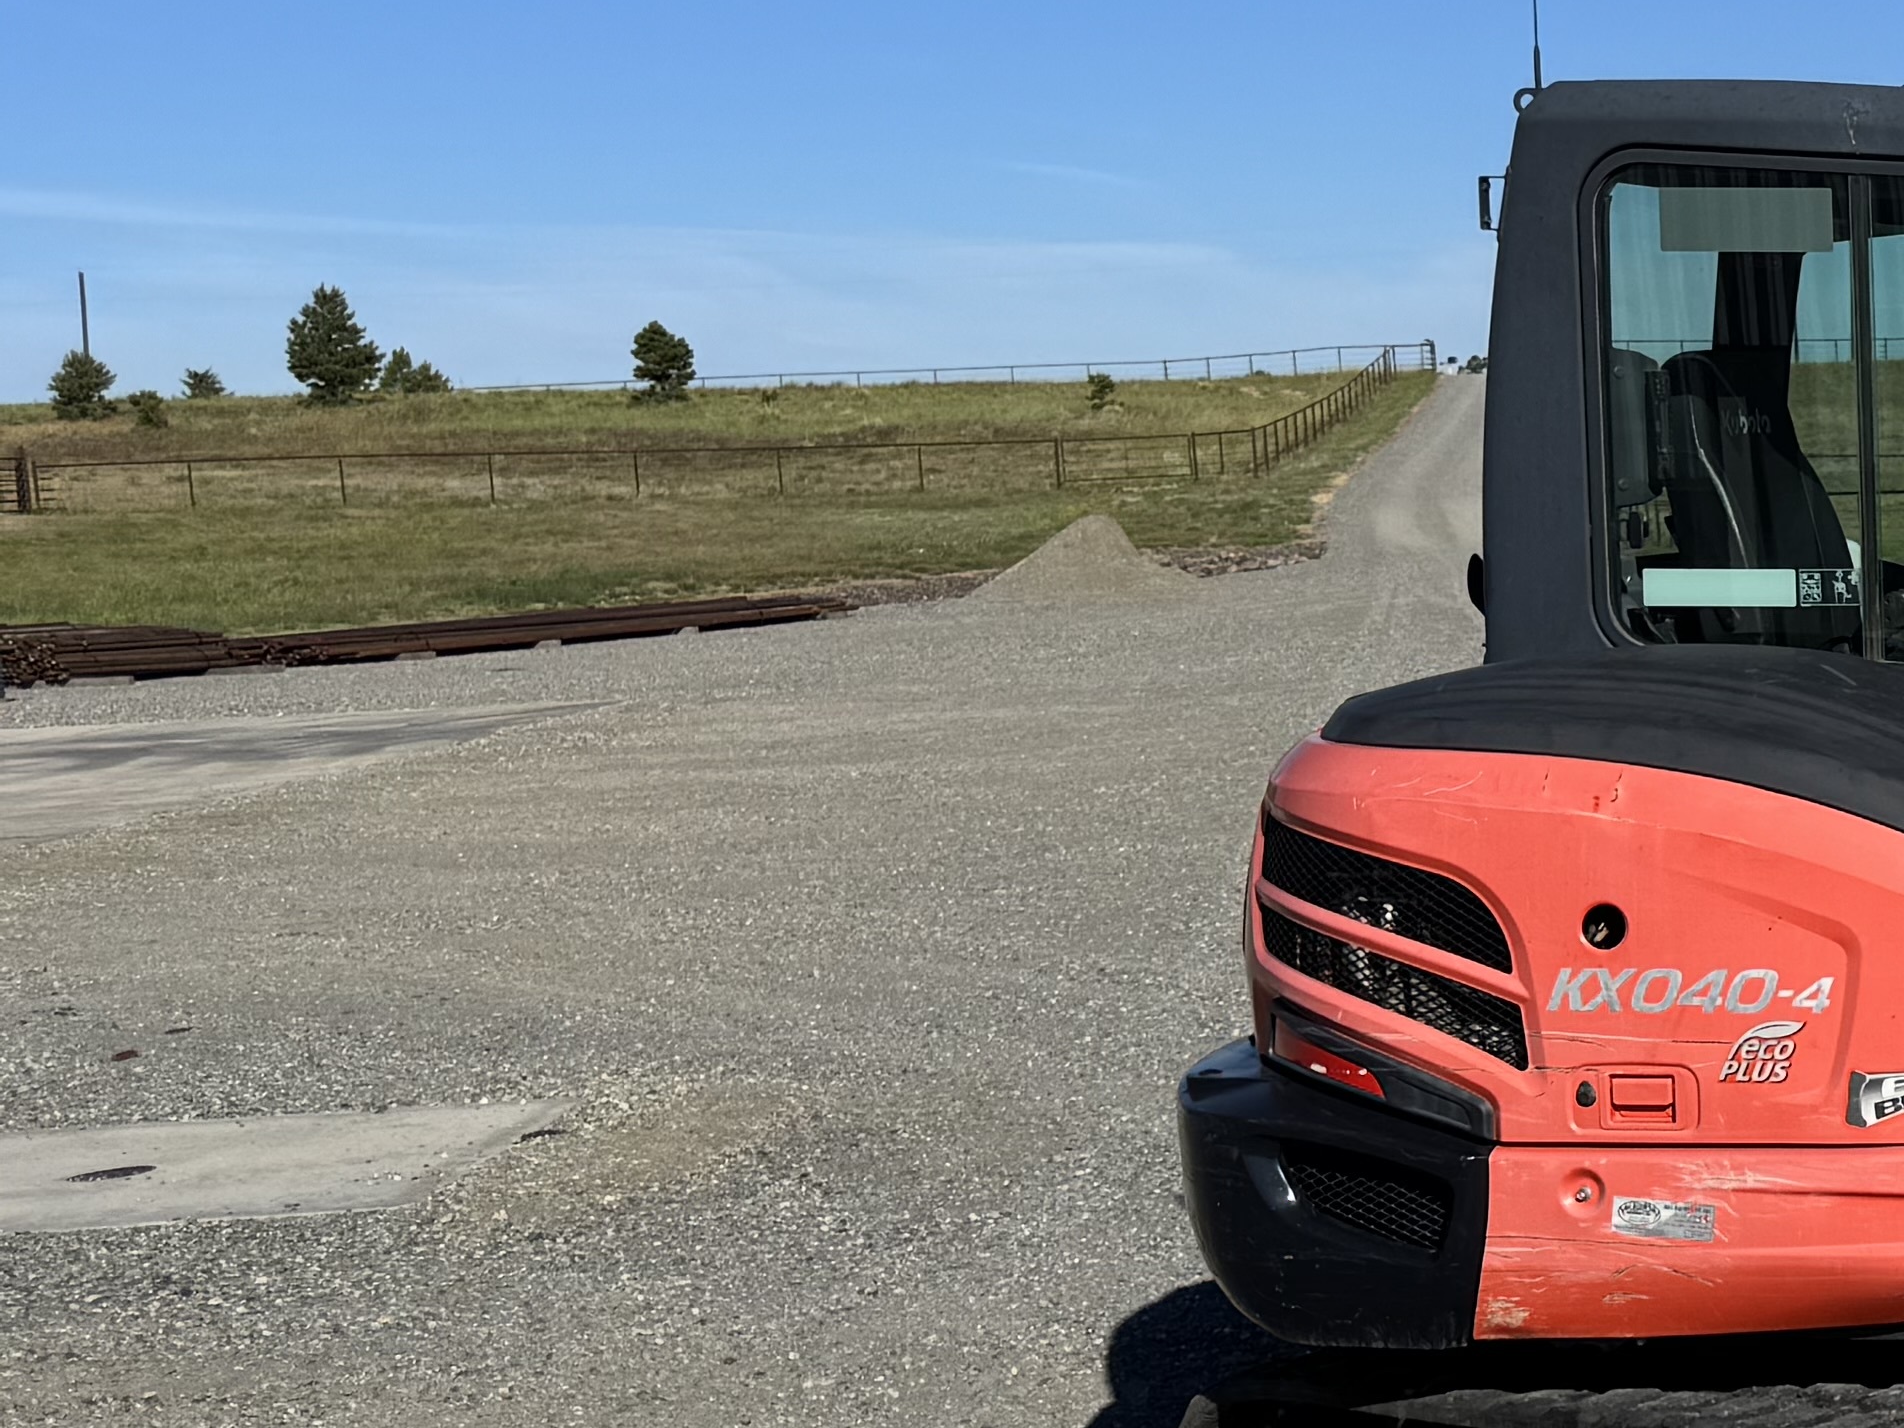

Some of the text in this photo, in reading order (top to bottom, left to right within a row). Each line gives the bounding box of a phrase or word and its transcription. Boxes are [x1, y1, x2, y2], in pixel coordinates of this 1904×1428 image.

[1546, 967, 1835, 1014] KX040-4
[1740, 1038, 1797, 1061] eco
[1719, 1059, 1792, 1083] PLUS
